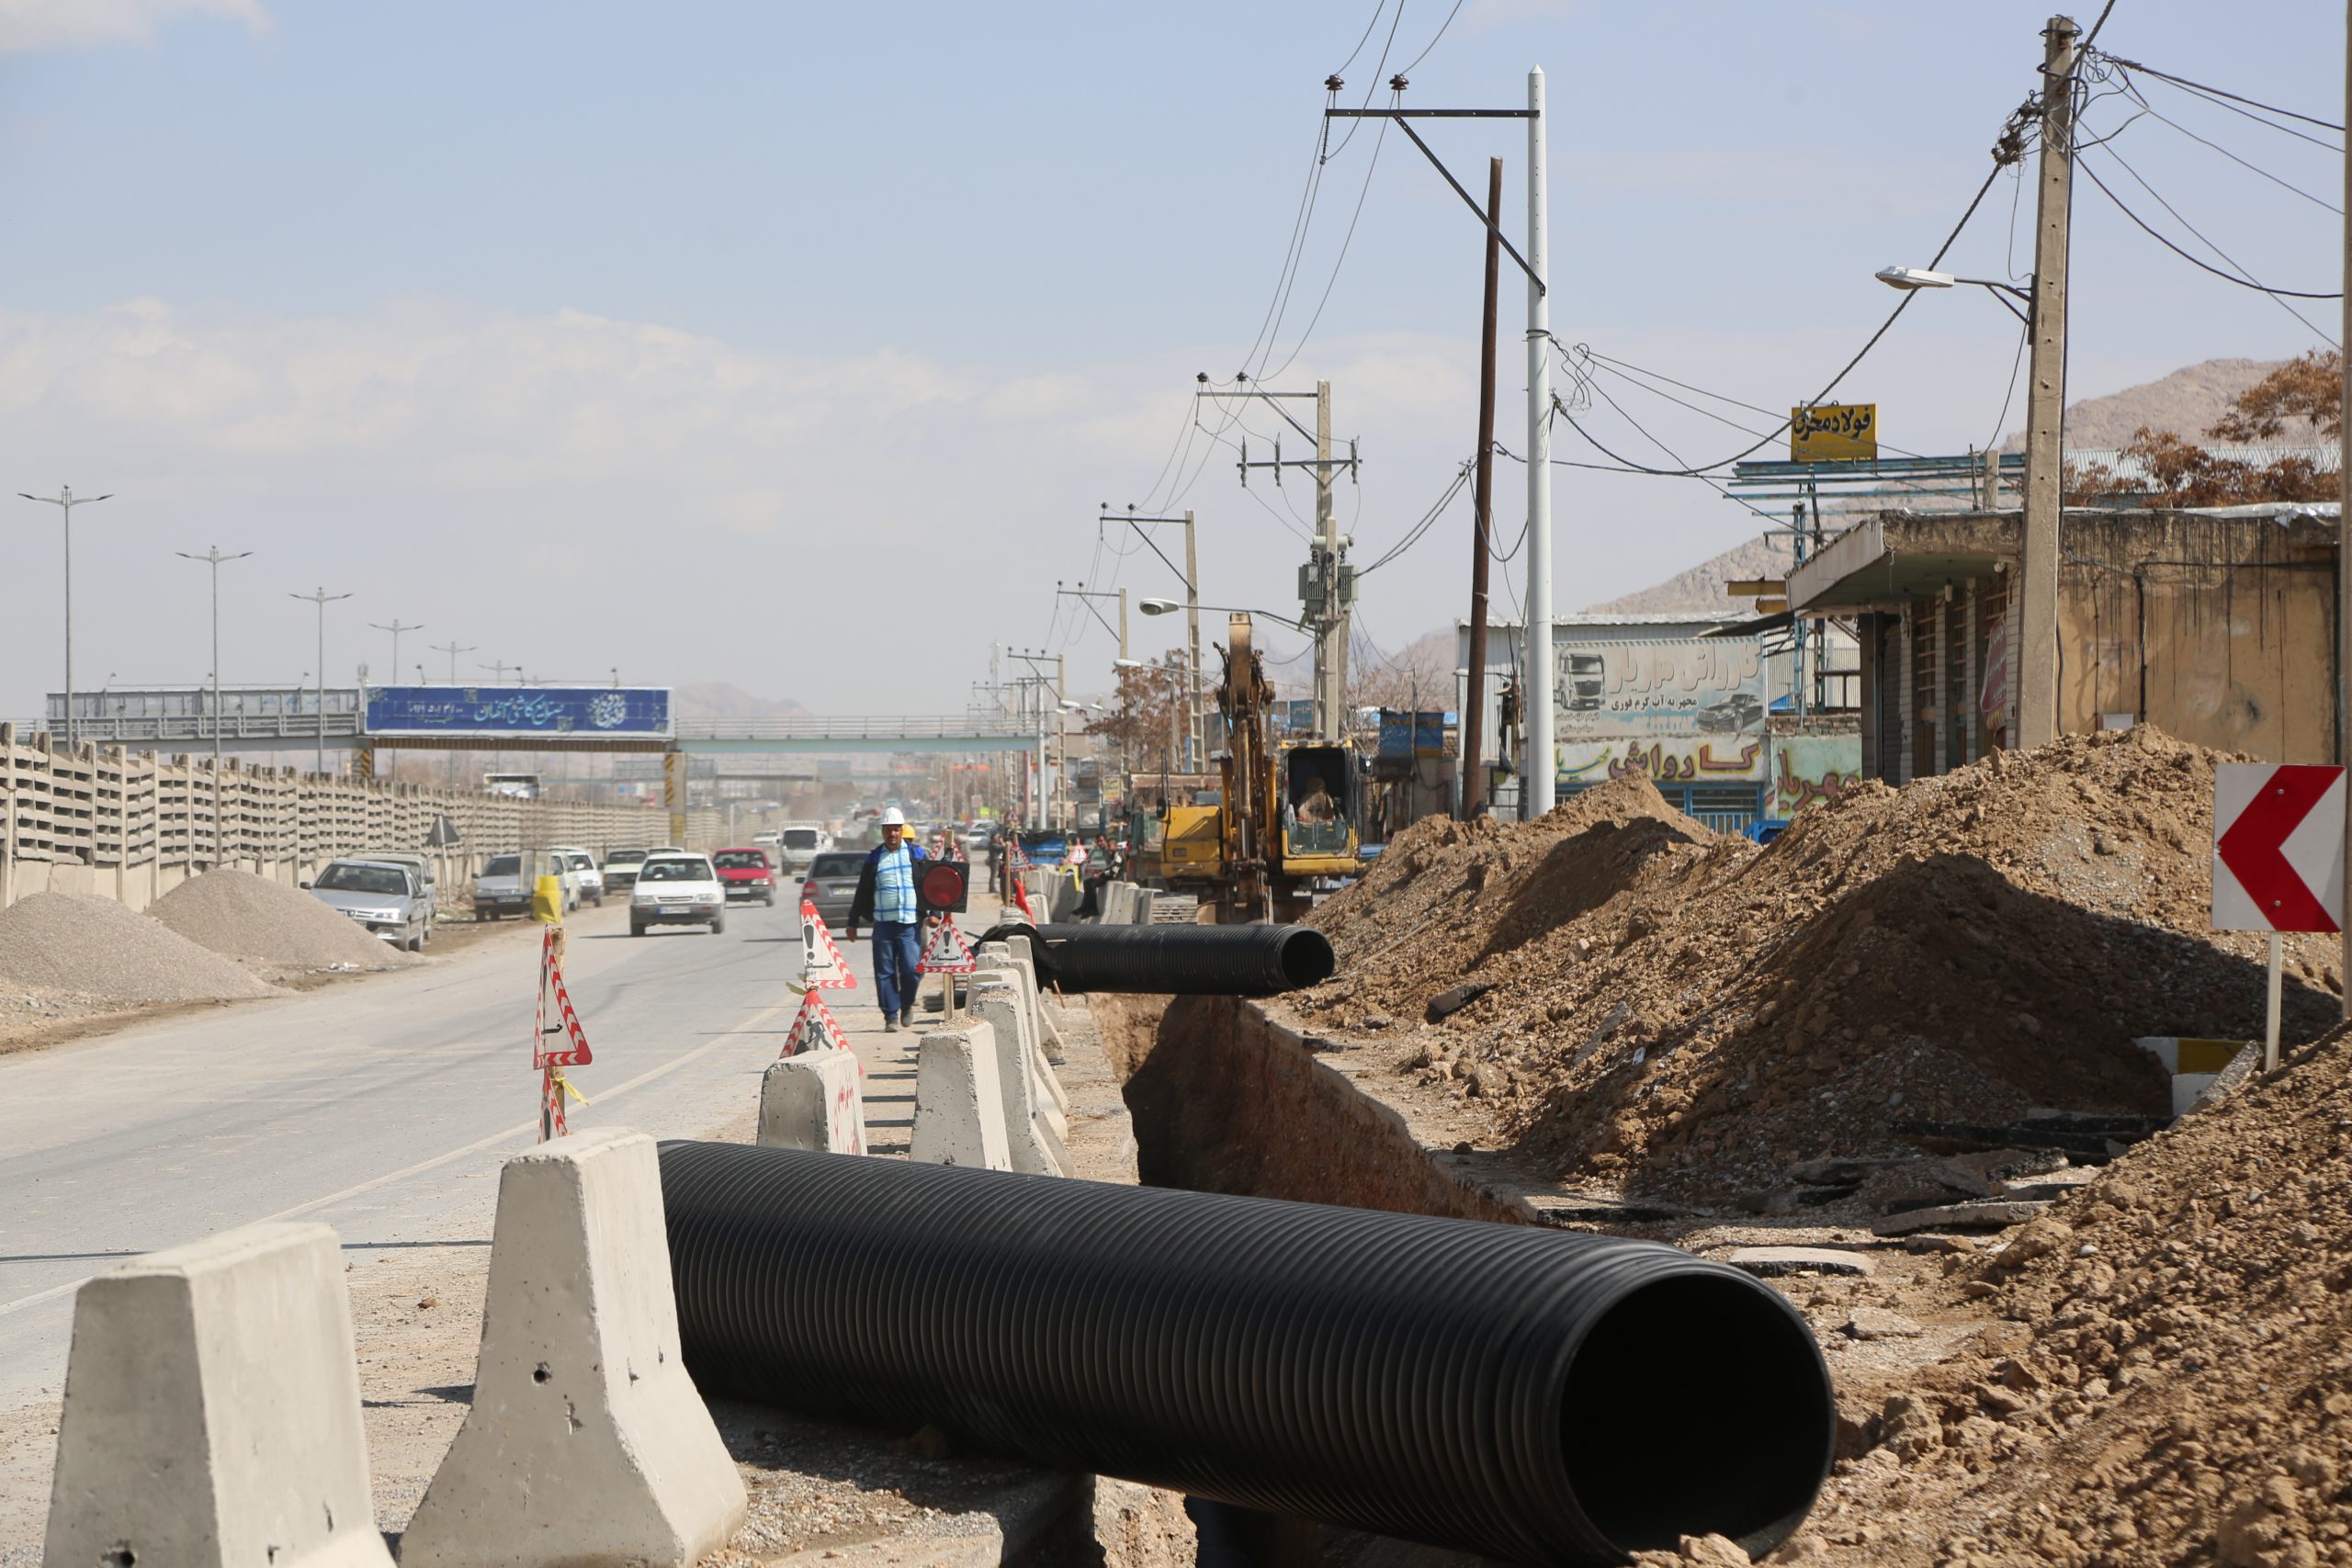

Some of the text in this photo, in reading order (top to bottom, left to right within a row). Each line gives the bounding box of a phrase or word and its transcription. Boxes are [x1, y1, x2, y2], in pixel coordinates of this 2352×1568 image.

[1832, 406, 1871, 439] فولاد
[1611, 695, 1633, 712] فوری
[1609, 740, 1759, 779] کارواش
